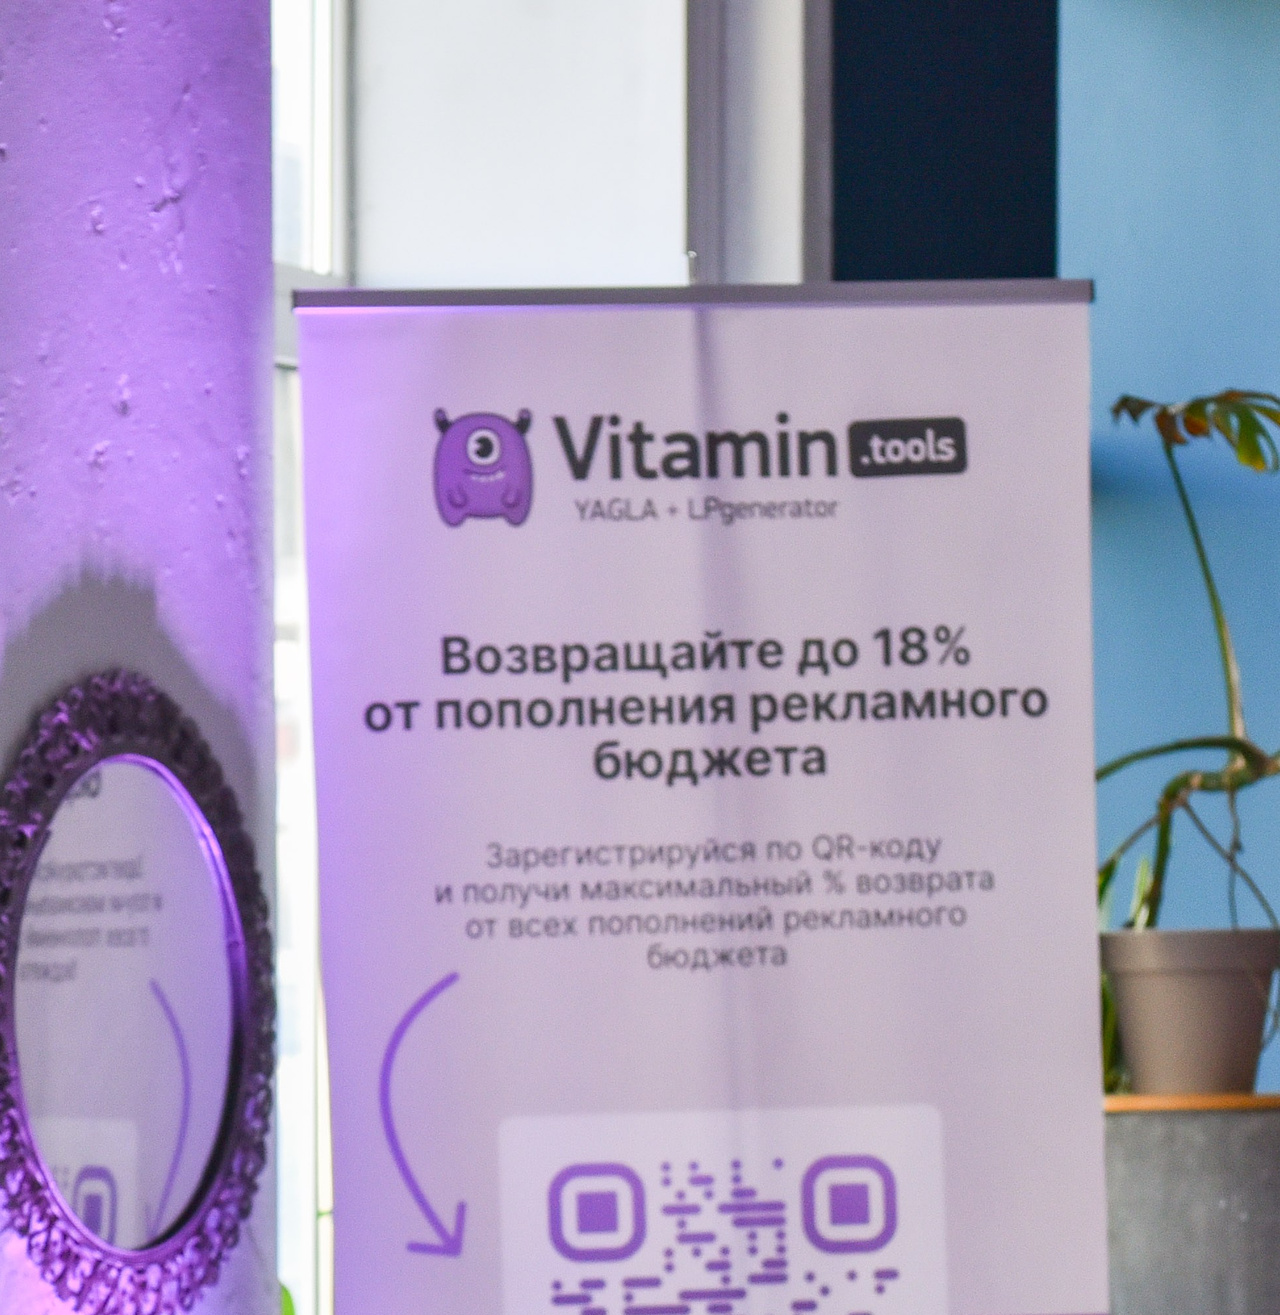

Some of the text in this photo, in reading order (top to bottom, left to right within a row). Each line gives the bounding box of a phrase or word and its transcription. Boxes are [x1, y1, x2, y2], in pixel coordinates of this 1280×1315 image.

[552, 411, 958, 481] Vitamin .tools
[574, 497, 659, 522] YAGLA
[687, 495, 840, 525] LPgenerator
[440, 624, 972, 682] Возвращайте до 18%
[363, 682, 1050, 734] от пополнения рекламного
[592, 740, 828, 787] бюджета
[486, 832, 942, 872] Зарегистрируйся по QR-коду
[435, 884, 454, 904] и
[463, 882, 571, 908] получи
[579, 870, 813, 902] максимальный
[855, 869, 996, 898] возврата
[465, 905, 968, 940] от всех пополнений рекламного
[646, 942, 789, 972] бюджета
